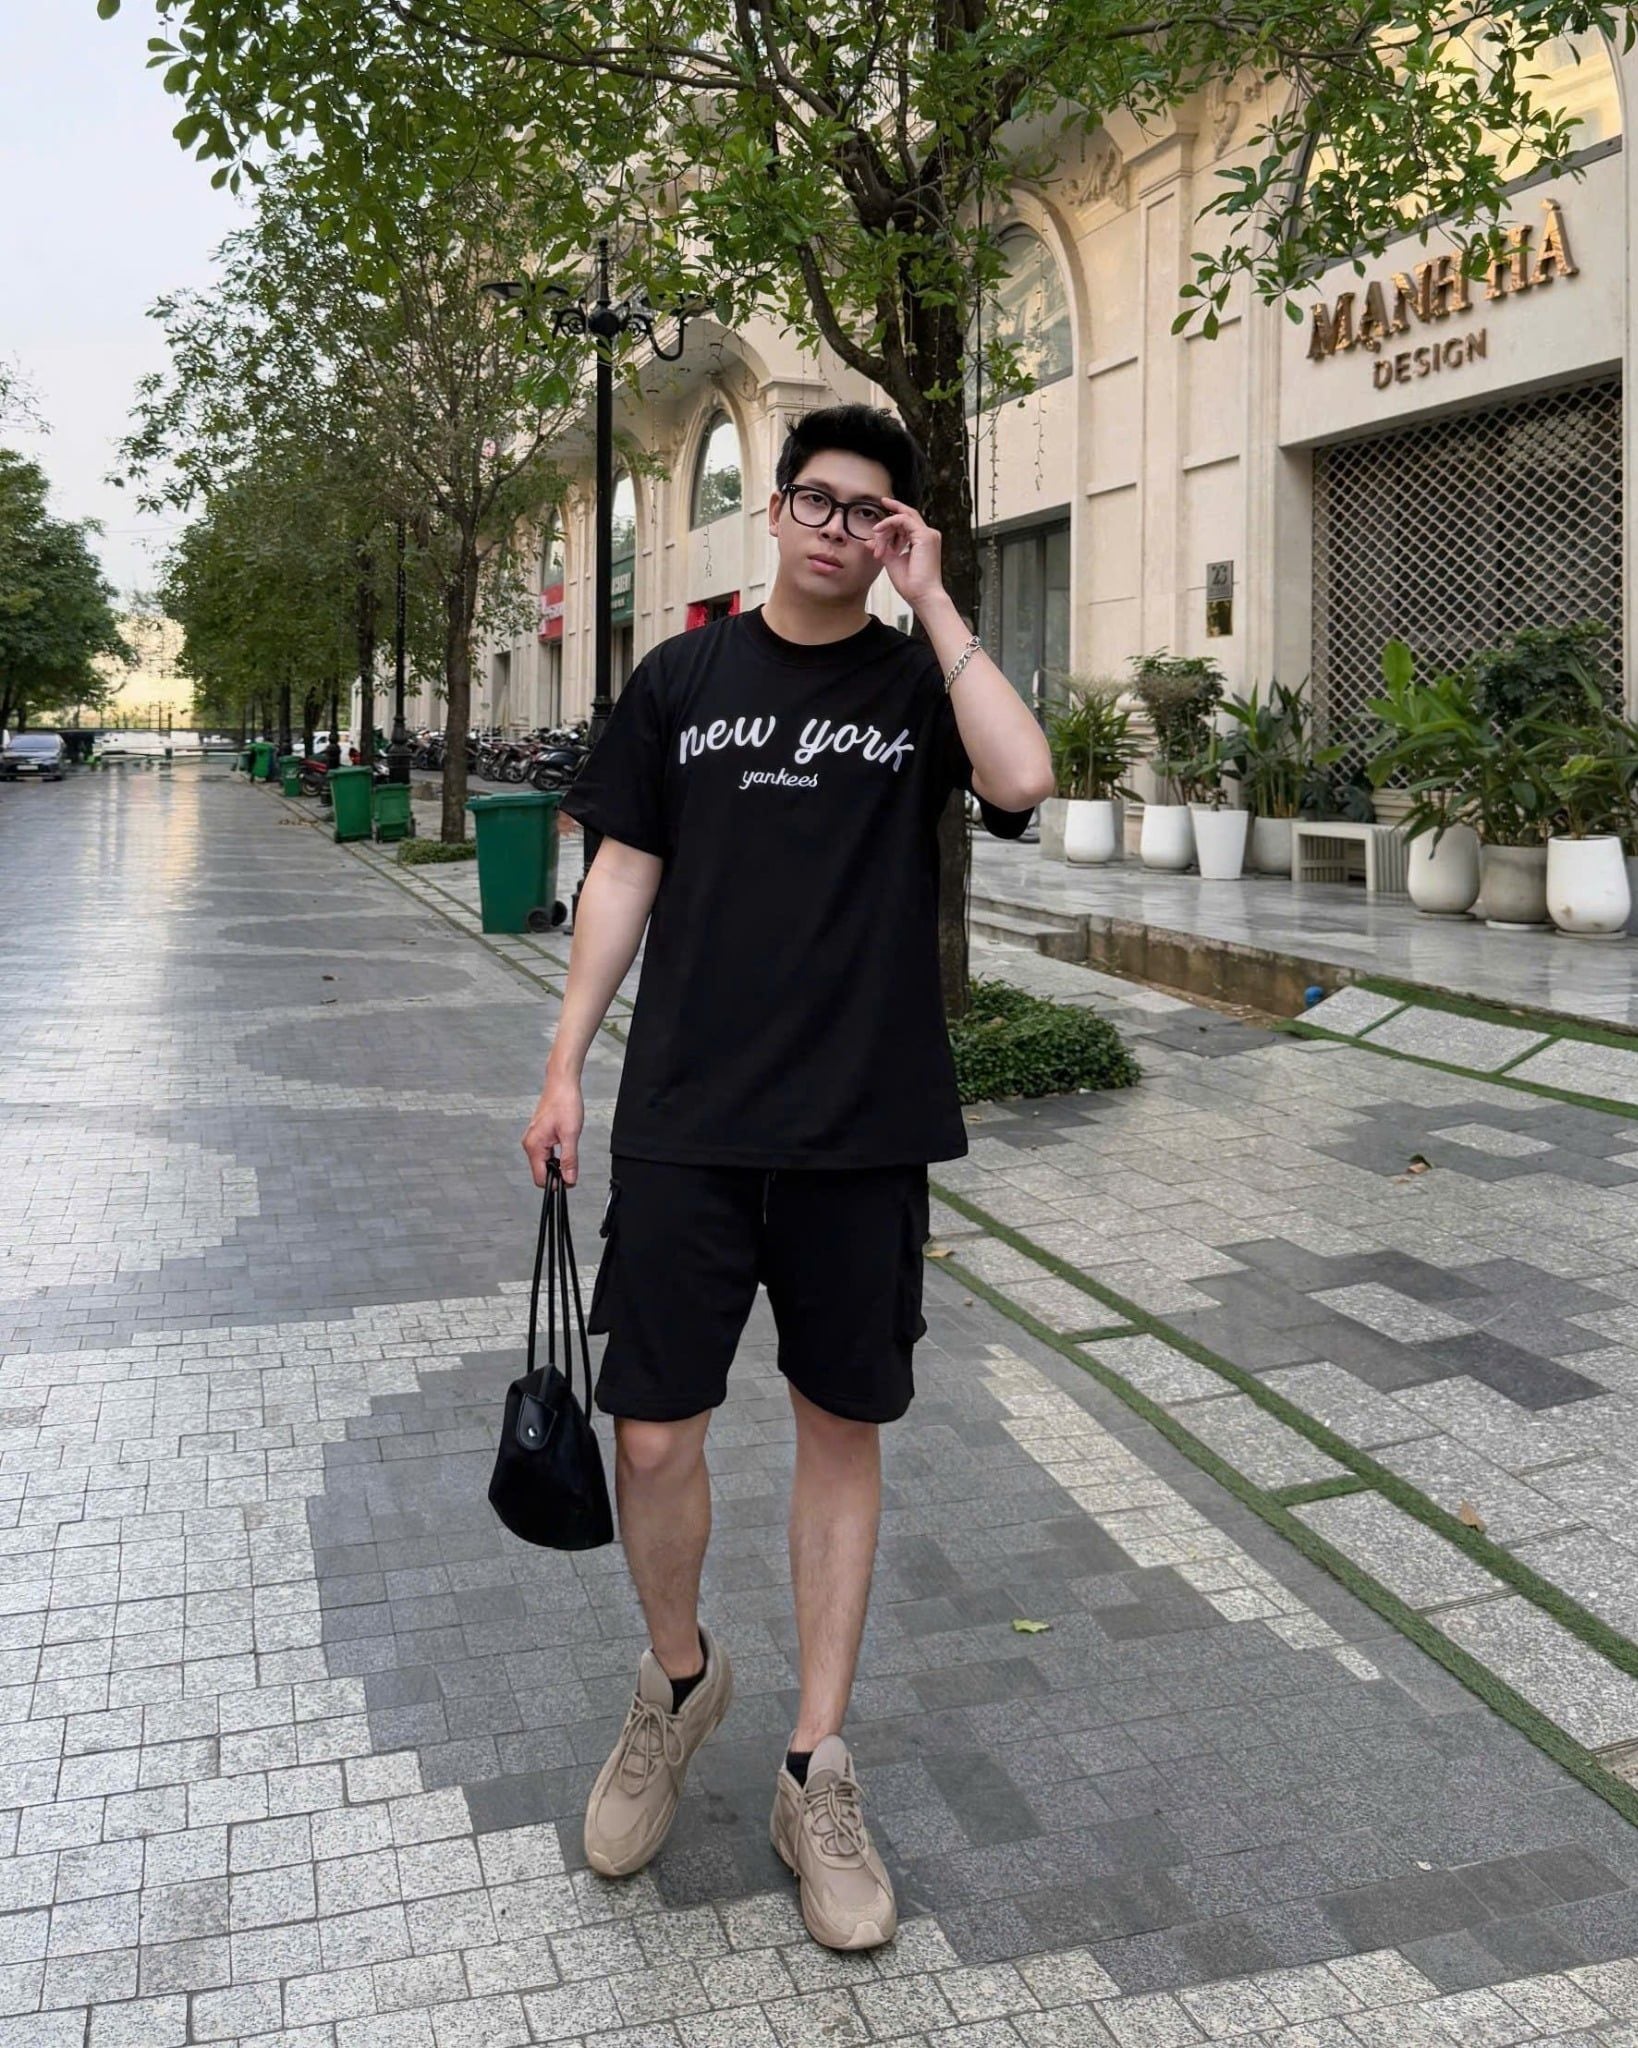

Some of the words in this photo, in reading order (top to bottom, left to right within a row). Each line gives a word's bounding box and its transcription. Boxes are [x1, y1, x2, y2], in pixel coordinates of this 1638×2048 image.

[1373, 328, 1487, 389] DESIGN
[794, 718, 915, 772] york
[738, 767, 818, 790] yankees
